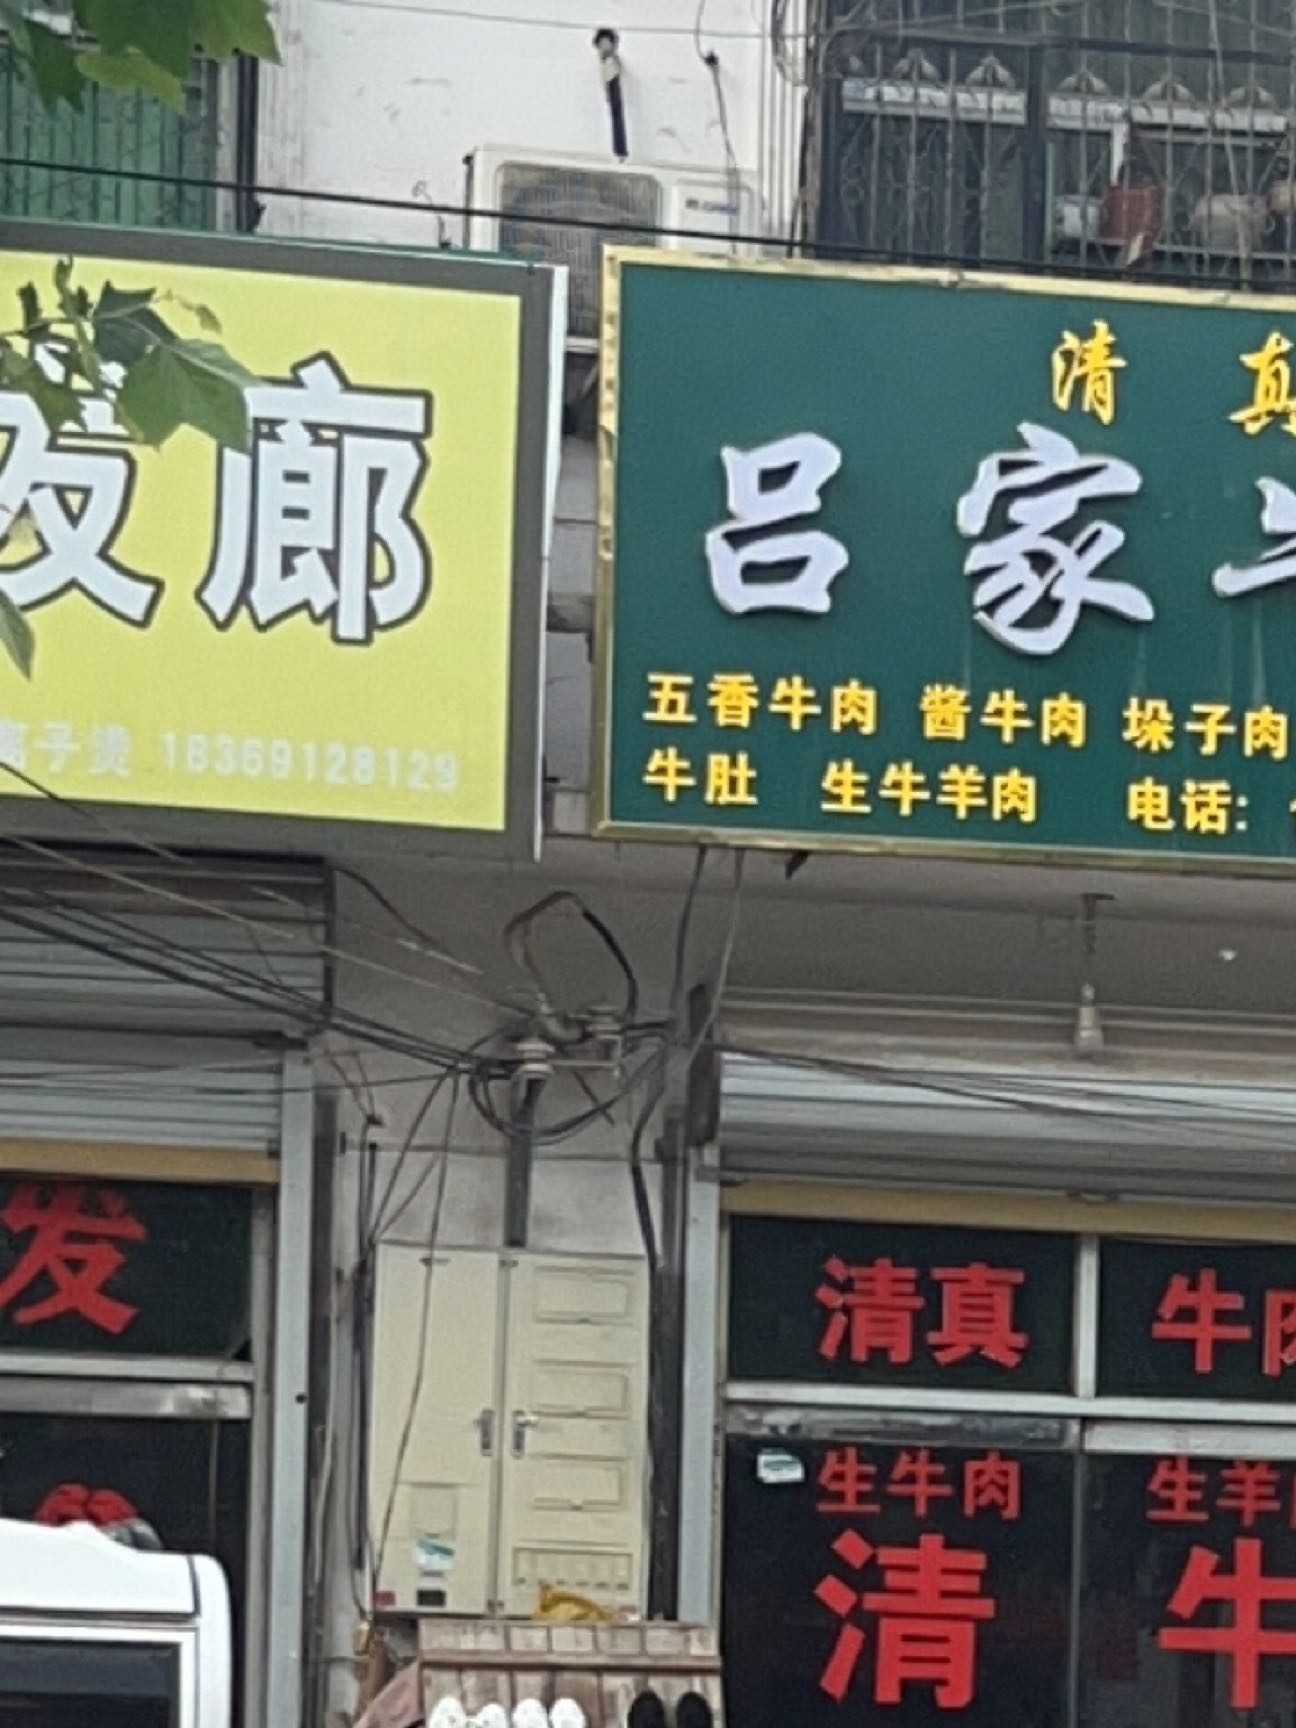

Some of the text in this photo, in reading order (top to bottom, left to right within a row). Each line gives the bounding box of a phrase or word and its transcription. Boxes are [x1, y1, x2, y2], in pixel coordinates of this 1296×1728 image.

[643, 672, 878, 735] 五香牛肉
[920, 683, 1086, 747] 酱牛肉
[1122, 696, 1288, 759] 垛子肉
[643, 747, 758, 806] 牛肚
[821, 759, 1037, 822] 生牛羊肉
[815, 1255, 1030, 1369] 清真
[816, 1446, 1022, 1520] 生牛肉
